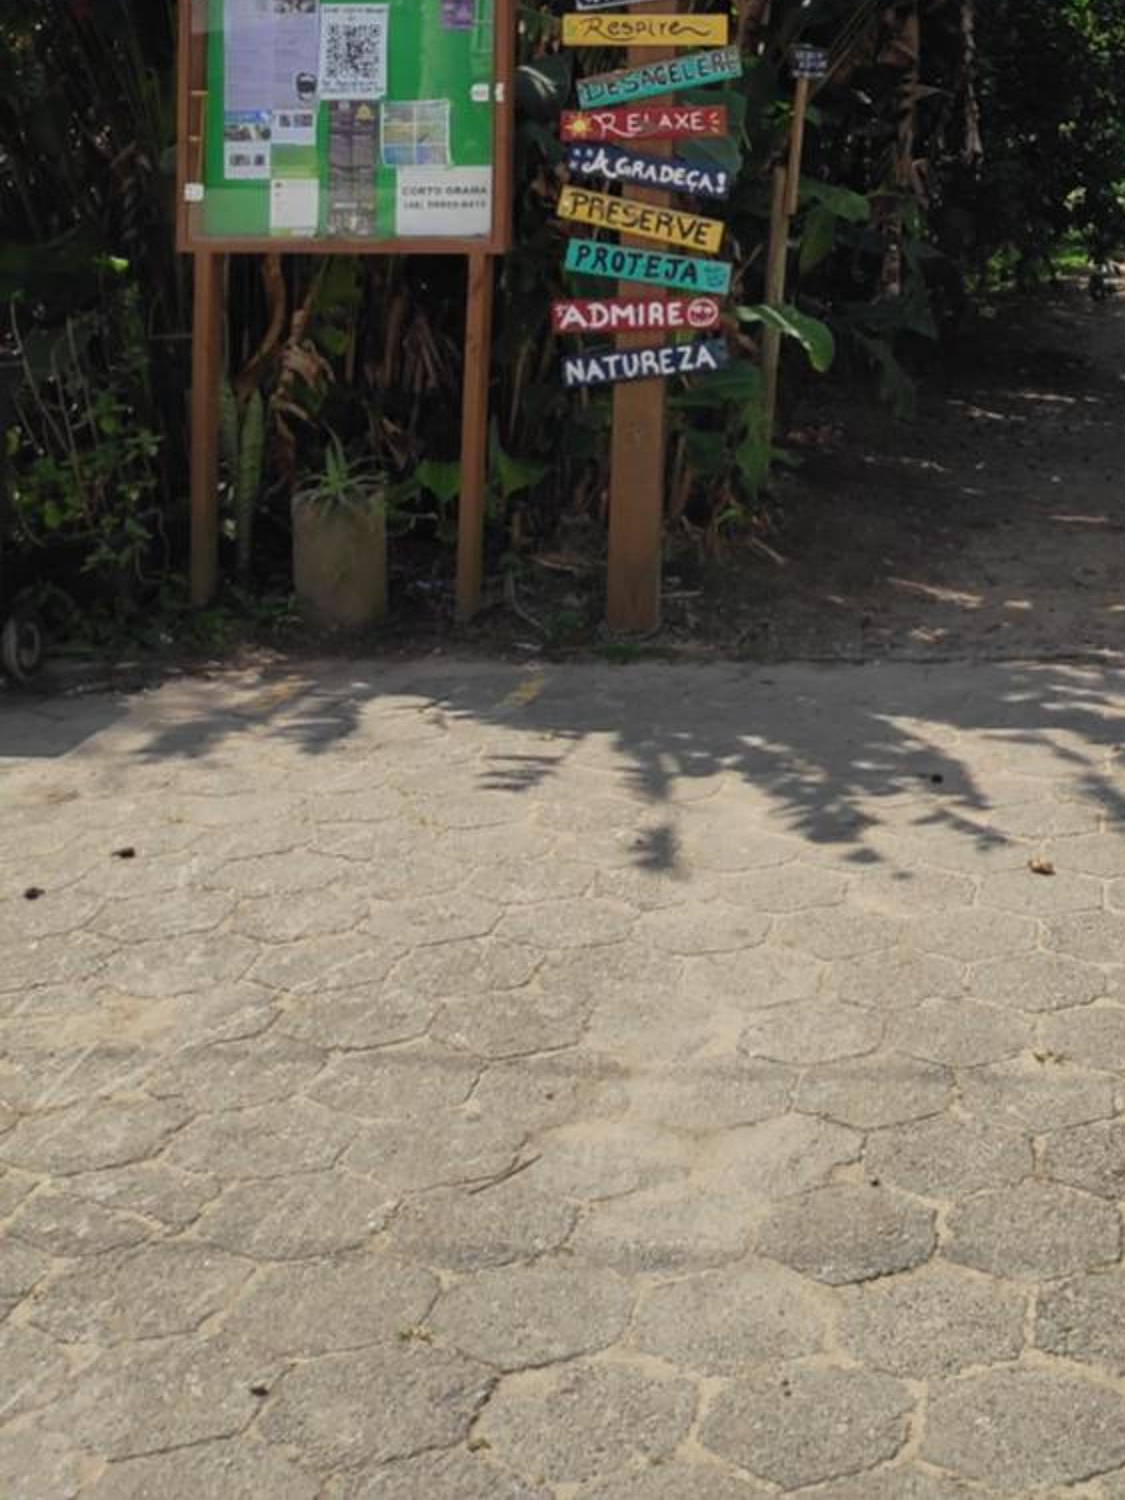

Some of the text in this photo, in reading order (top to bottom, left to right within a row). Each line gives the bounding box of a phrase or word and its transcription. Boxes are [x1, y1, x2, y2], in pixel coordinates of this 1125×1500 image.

[581, 17, 712, 42] Respire
[568, 190, 713, 247] PRESERVE
[573, 243, 699, 286] PROTEJA
[558, 301, 685, 329] ADMIRE
[563, 344, 718, 386] NATUREZA
